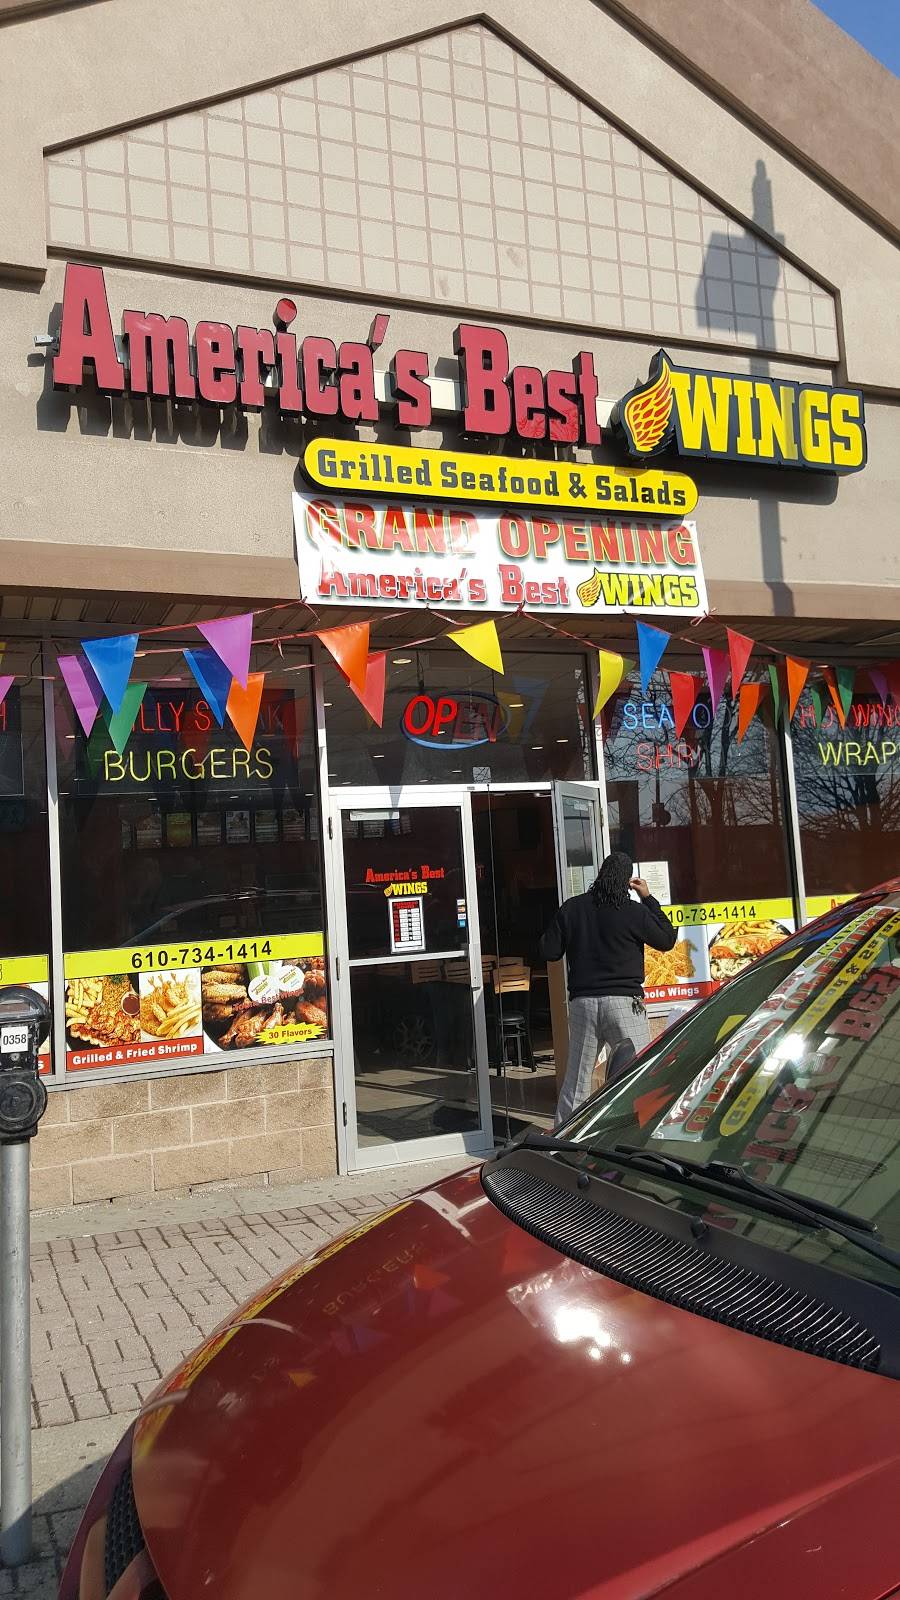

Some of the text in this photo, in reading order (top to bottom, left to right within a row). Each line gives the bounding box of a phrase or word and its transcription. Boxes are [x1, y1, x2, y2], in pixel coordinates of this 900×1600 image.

[53, 262, 865, 467] America's Best WINGS
[317, 449, 686, 507] Grilled Seafood & Salads
[305, 500, 697, 565] GRAND OPENING
[317, 555, 700, 608] America's Best WINGS
[404, 694, 501, 743] OPEN
[104, 748, 273, 782] BURGERS
[421, 864, 445, 880] Best
[391, 881, 428, 896] WINGS
[666, 904, 758, 924] 10-734-1414
[131, 941, 273, 969] 610-734-1414
[644, 987, 700, 999] hole Wings
[3, 1034, 27, 1045] 0358
[268, 1028, 313, 1040] 30 Flavors
[72, 1042, 198, 1066] Grilled & Fried Shrimp
